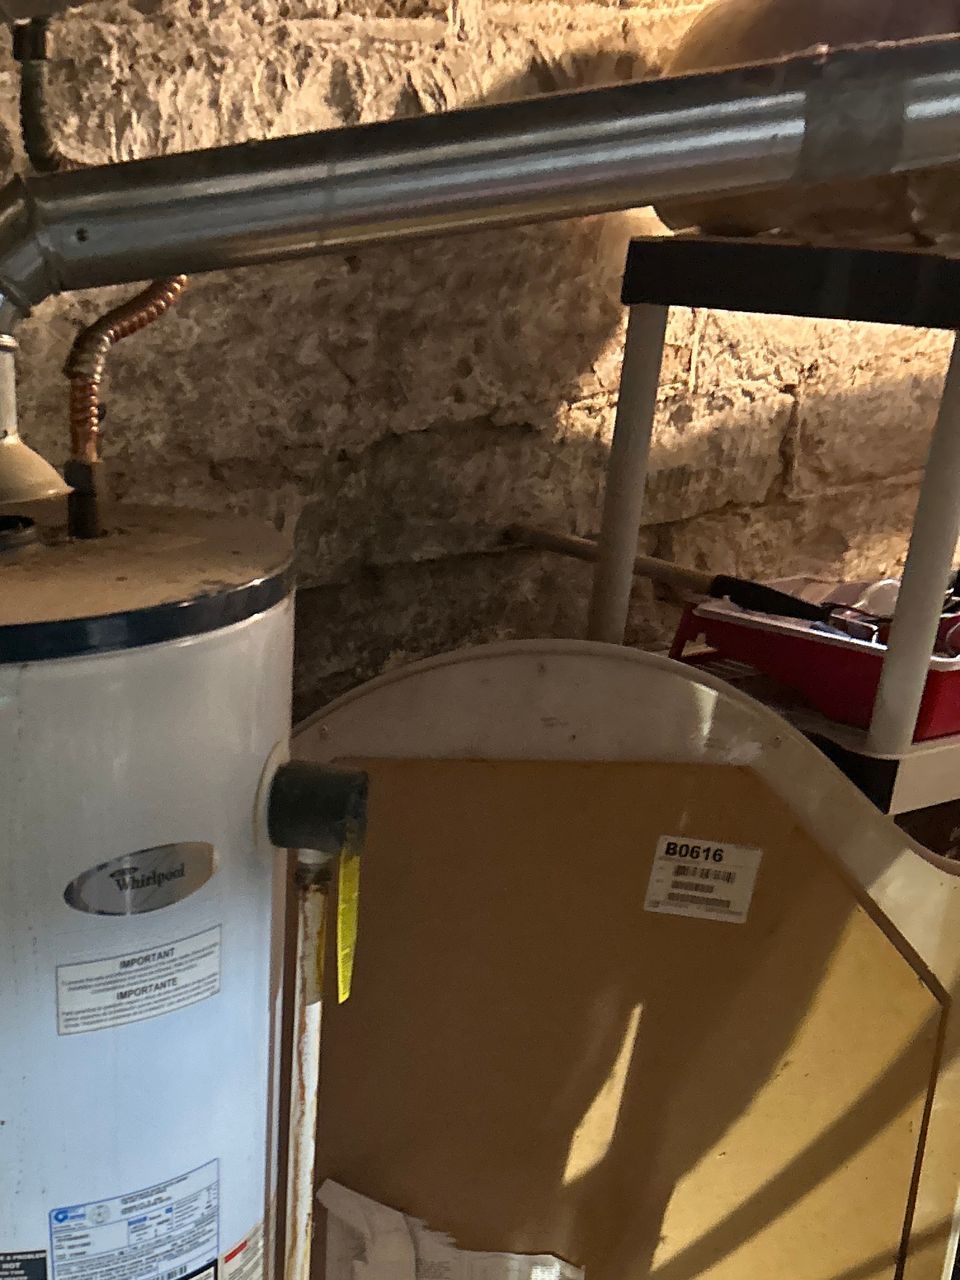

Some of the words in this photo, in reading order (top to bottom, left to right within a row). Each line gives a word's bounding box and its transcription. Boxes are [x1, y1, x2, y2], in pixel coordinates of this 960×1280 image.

[664, 841, 725, 863] B0616
[115, 862, 186, 893] Whirlpool
[119, 947, 176, 970] IMPORTANT
[116, 976, 179, 1001] IMPORTANTE
[2, 1262, 21, 1270] NOT
